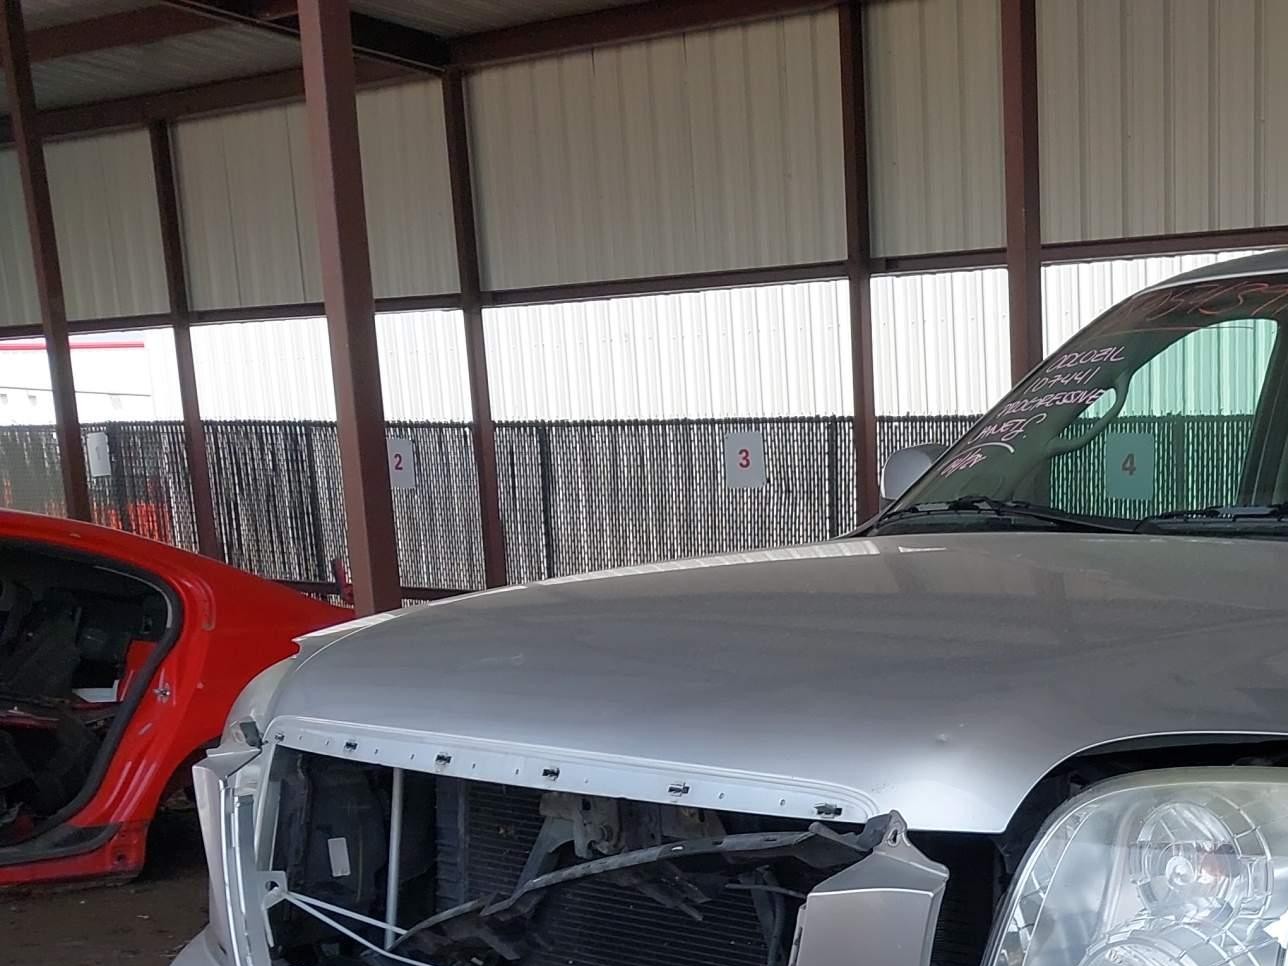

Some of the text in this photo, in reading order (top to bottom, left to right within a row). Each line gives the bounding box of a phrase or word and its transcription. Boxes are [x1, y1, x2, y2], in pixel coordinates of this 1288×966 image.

[394, 453, 403, 470] 2
[738, 448, 751, 468] 3
[1122, 453, 1136, 475] 4
